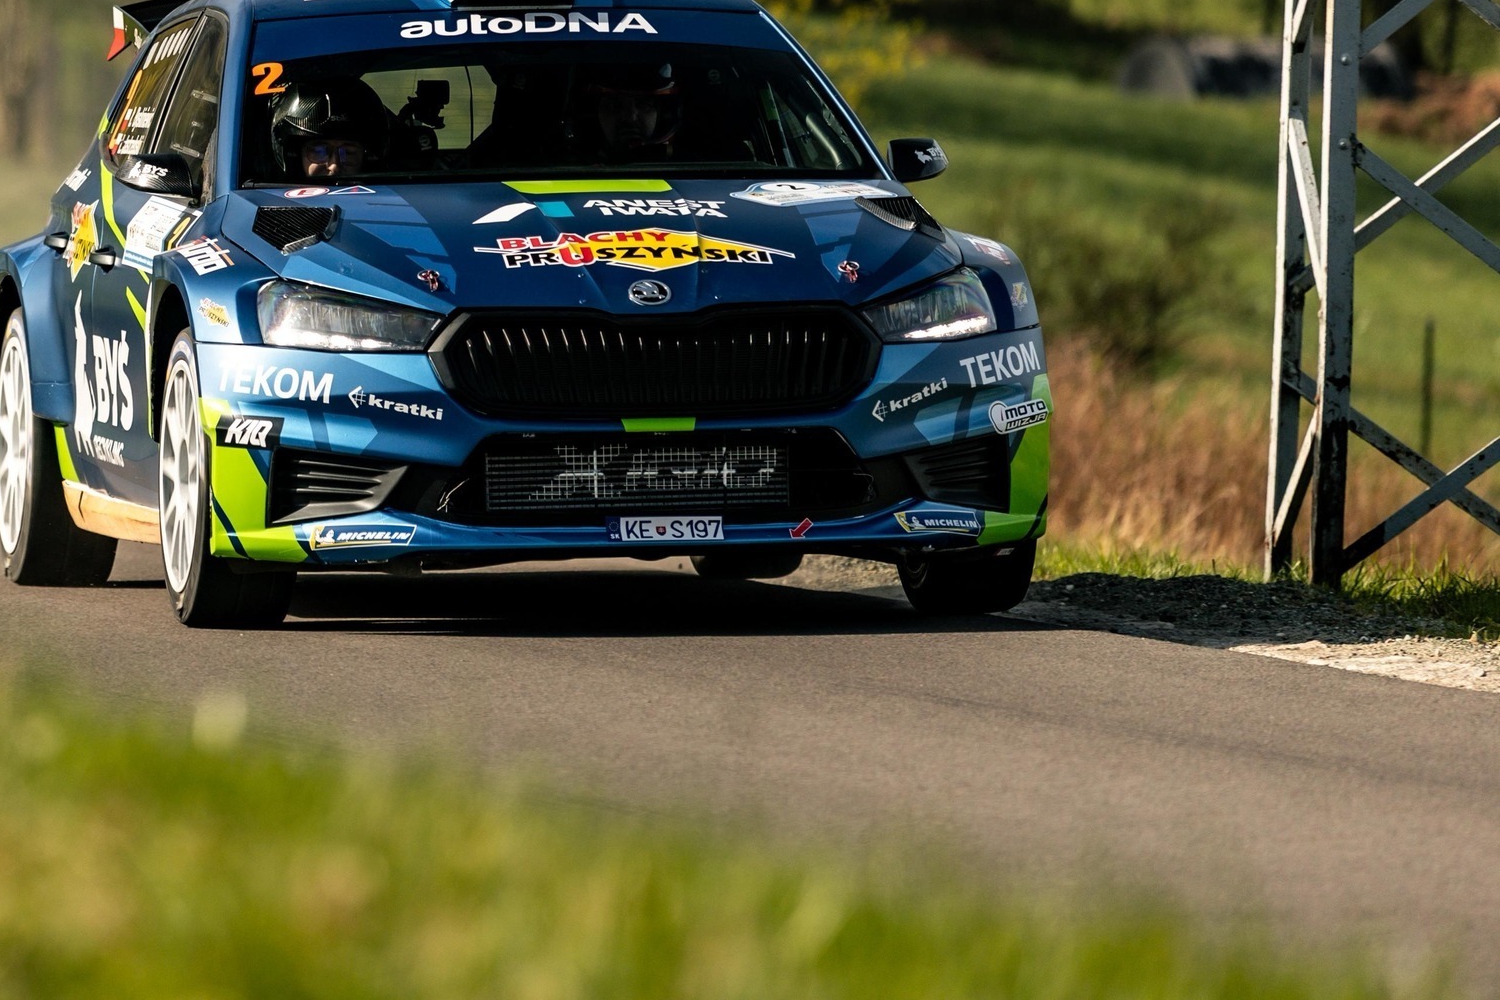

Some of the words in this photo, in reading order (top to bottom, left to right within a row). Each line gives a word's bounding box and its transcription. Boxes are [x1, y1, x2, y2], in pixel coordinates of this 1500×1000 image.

[400, 12, 658, 38] autoDNA
[252, 62, 285, 95] 2
[583, 199, 726, 209] ANEST
[600, 206, 729, 218] IWATA
[499, 230, 672, 250] BLACHY
[505, 242, 773, 268] PRUSZYŃSKI
[959, 341, 1041, 389] TEKOM
[92, 329, 134, 432] BYŚ
[218, 361, 335, 405] TEKOM
[889, 377, 948, 413] kratki
[368, 394, 444, 421] kratki
[1005, 400, 1046, 420] MOTO
[1006, 412, 1047, 430] WIZJA
[625, 520, 654, 539] KE
[670, 519, 721, 539] S197
[923, 518, 978, 528] MICHELIN
[337, 531, 411, 541] MICHELIN
